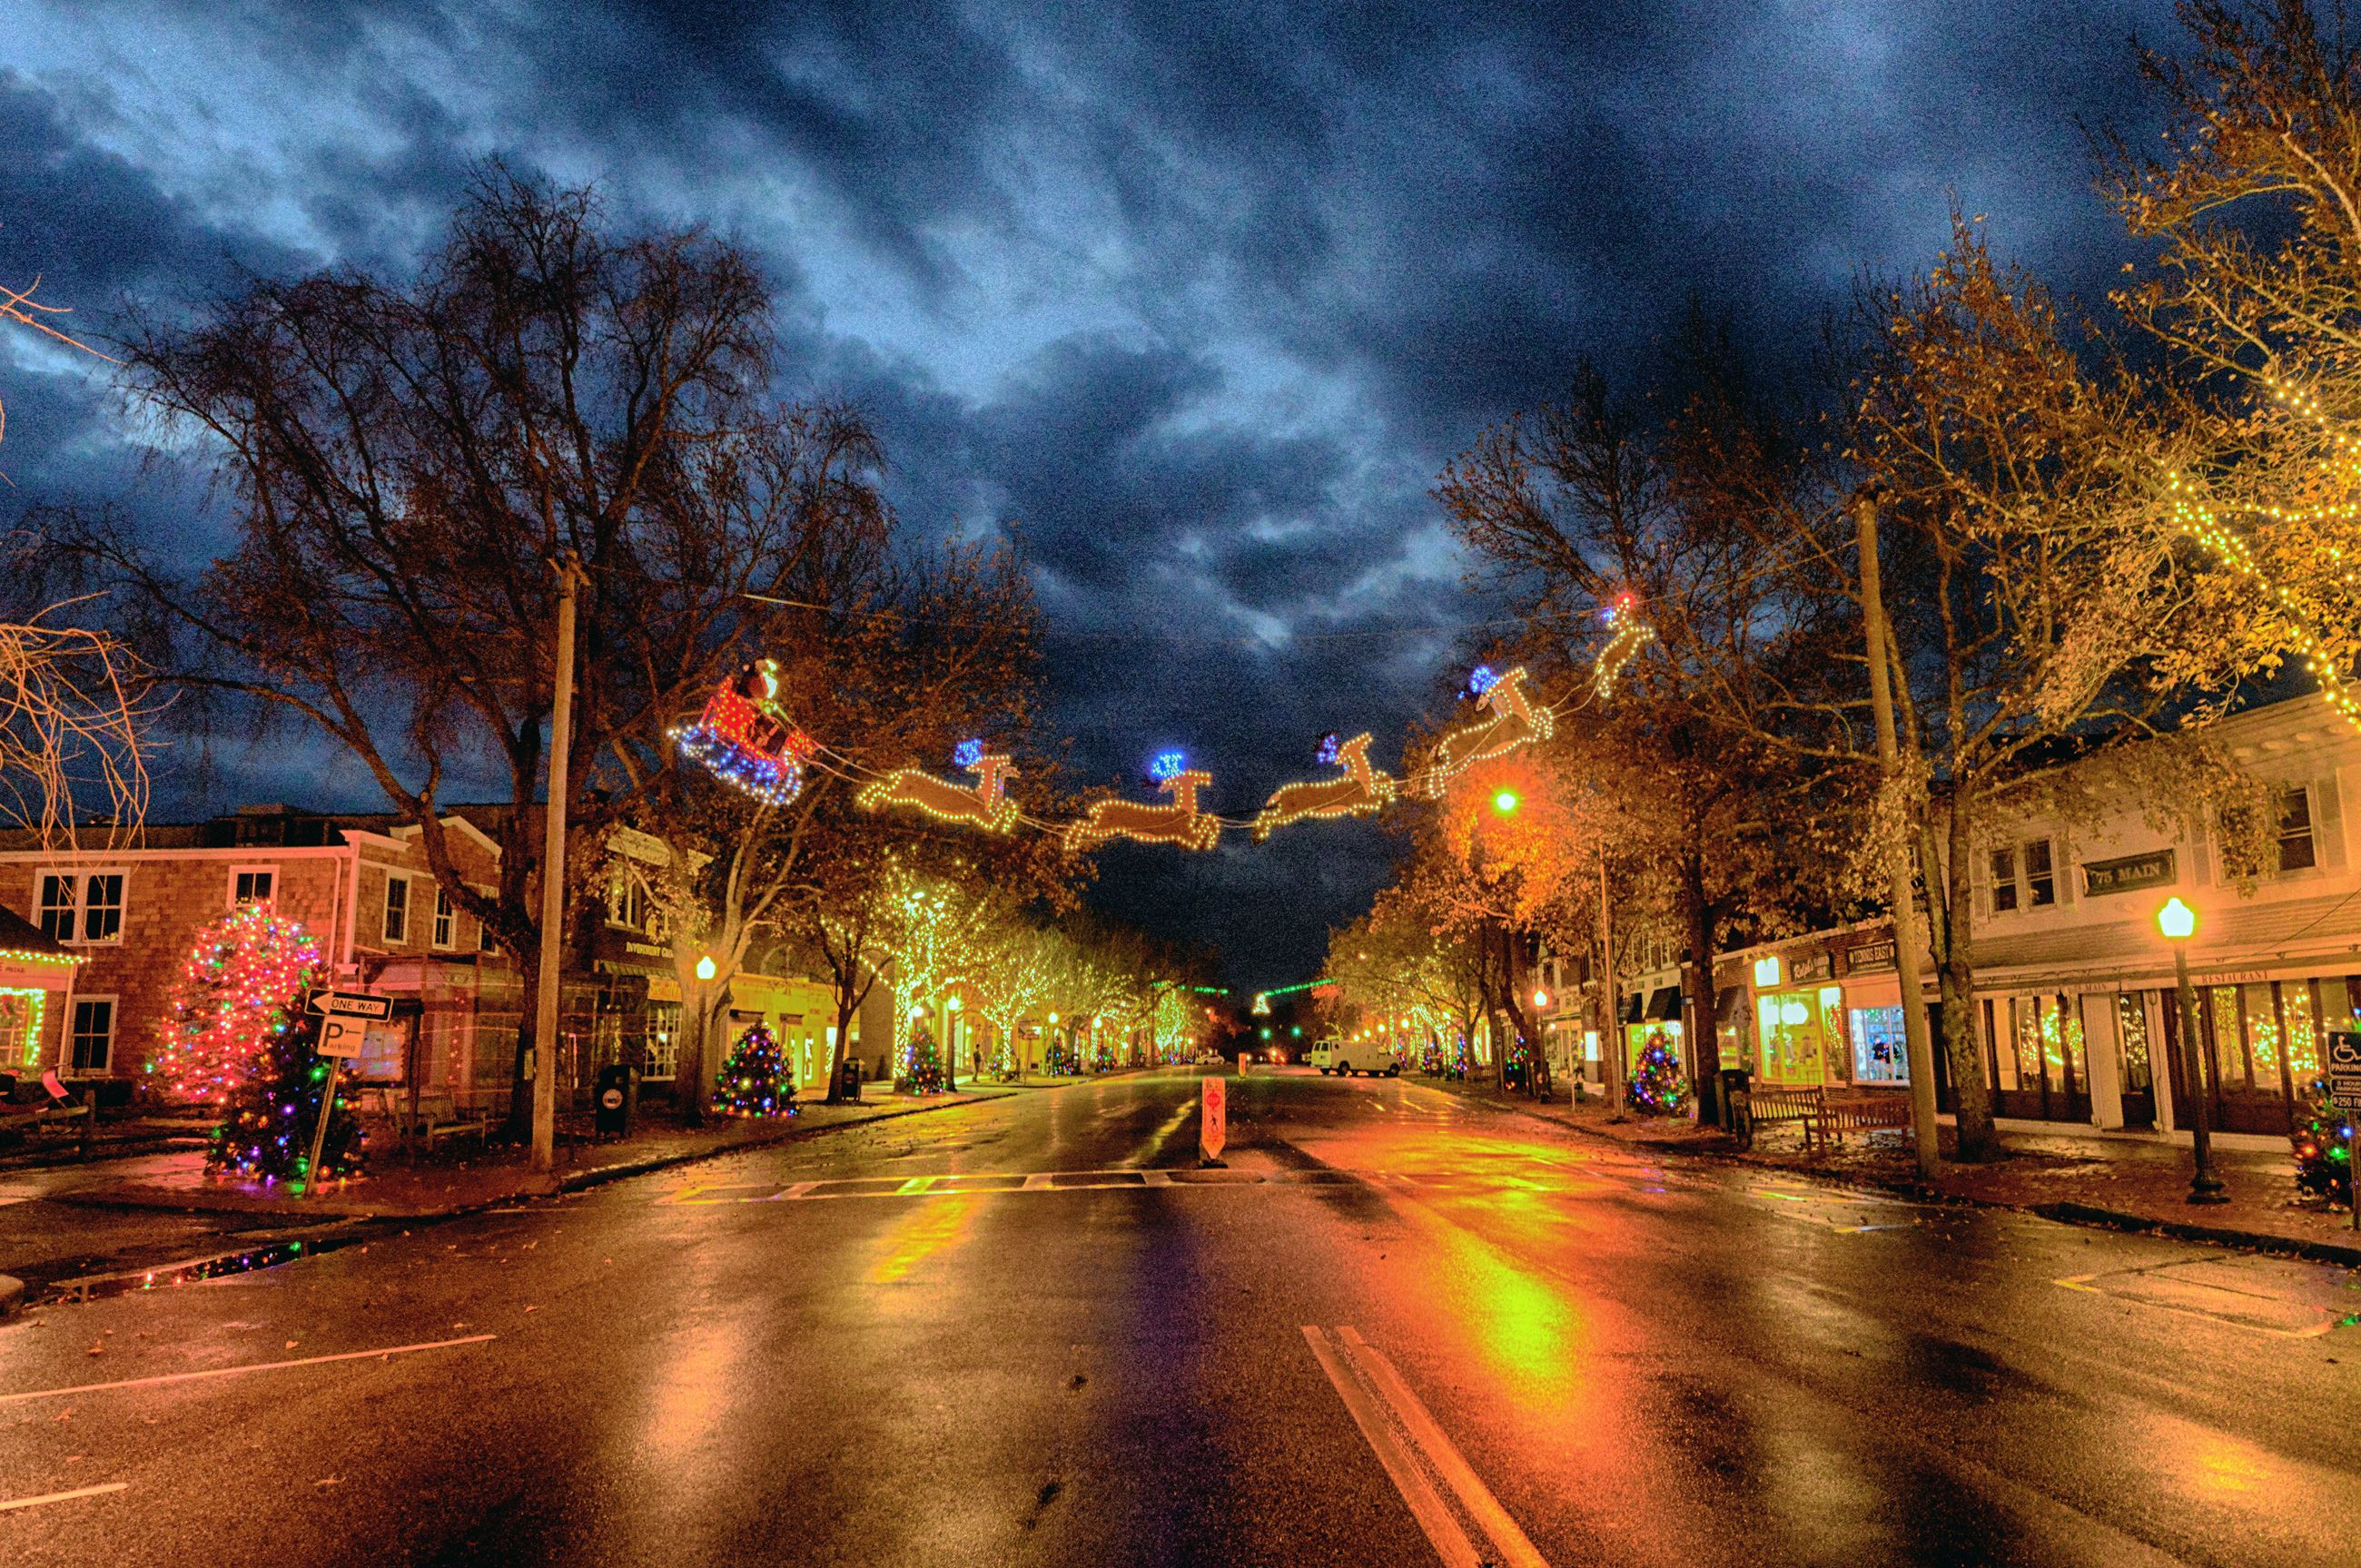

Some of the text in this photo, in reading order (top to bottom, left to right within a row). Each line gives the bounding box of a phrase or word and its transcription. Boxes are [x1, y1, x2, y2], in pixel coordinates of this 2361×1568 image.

[2119, 862, 2160, 880] MAIN
[1874, 945, 1889, 961] EAST
[2201, 971, 2267, 984] RESTAURANT
[331, 999, 380, 1011] ONE WAY
